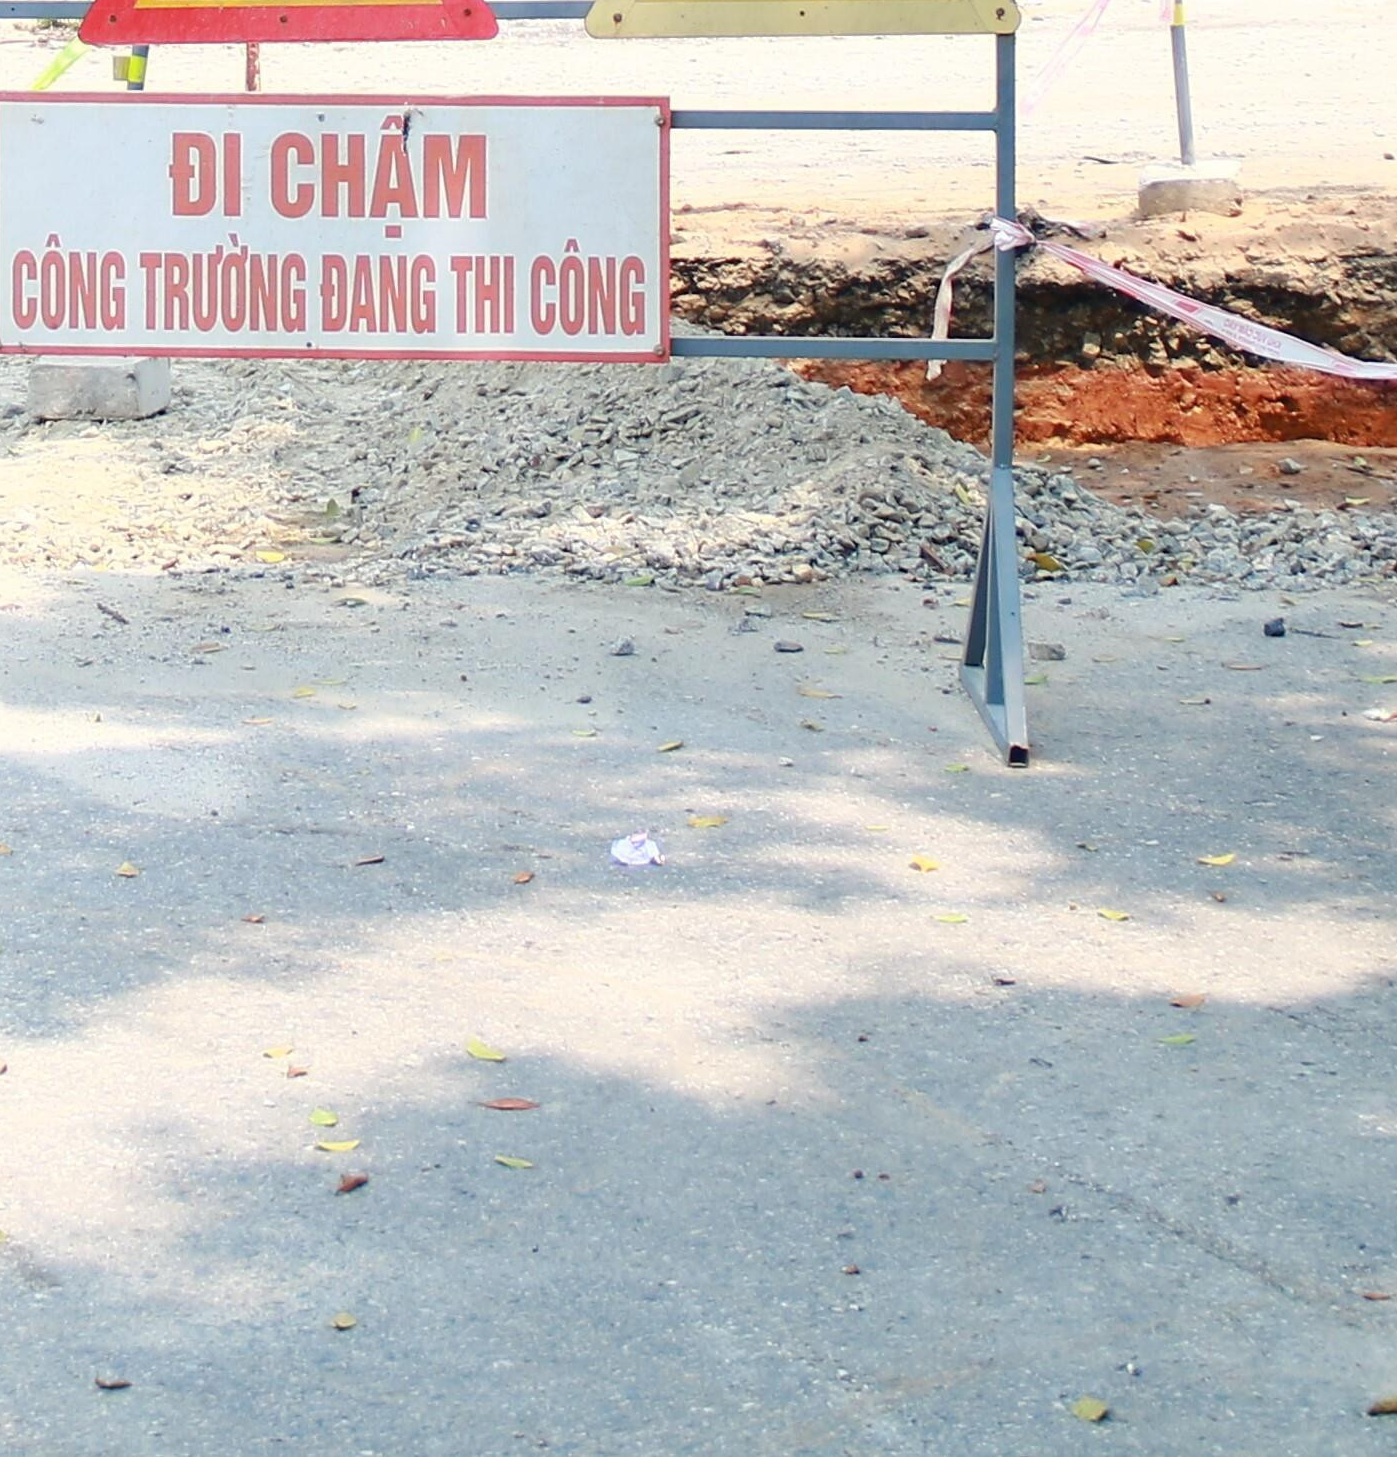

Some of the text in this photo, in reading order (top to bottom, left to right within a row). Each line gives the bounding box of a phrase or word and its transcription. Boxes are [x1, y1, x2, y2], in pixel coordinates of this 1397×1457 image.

[169, 115, 488, 239] ĐI CHẬM
[12, 233, 646, 336] CÔNG TRƯỜNG ĐANG THI CÔNG
